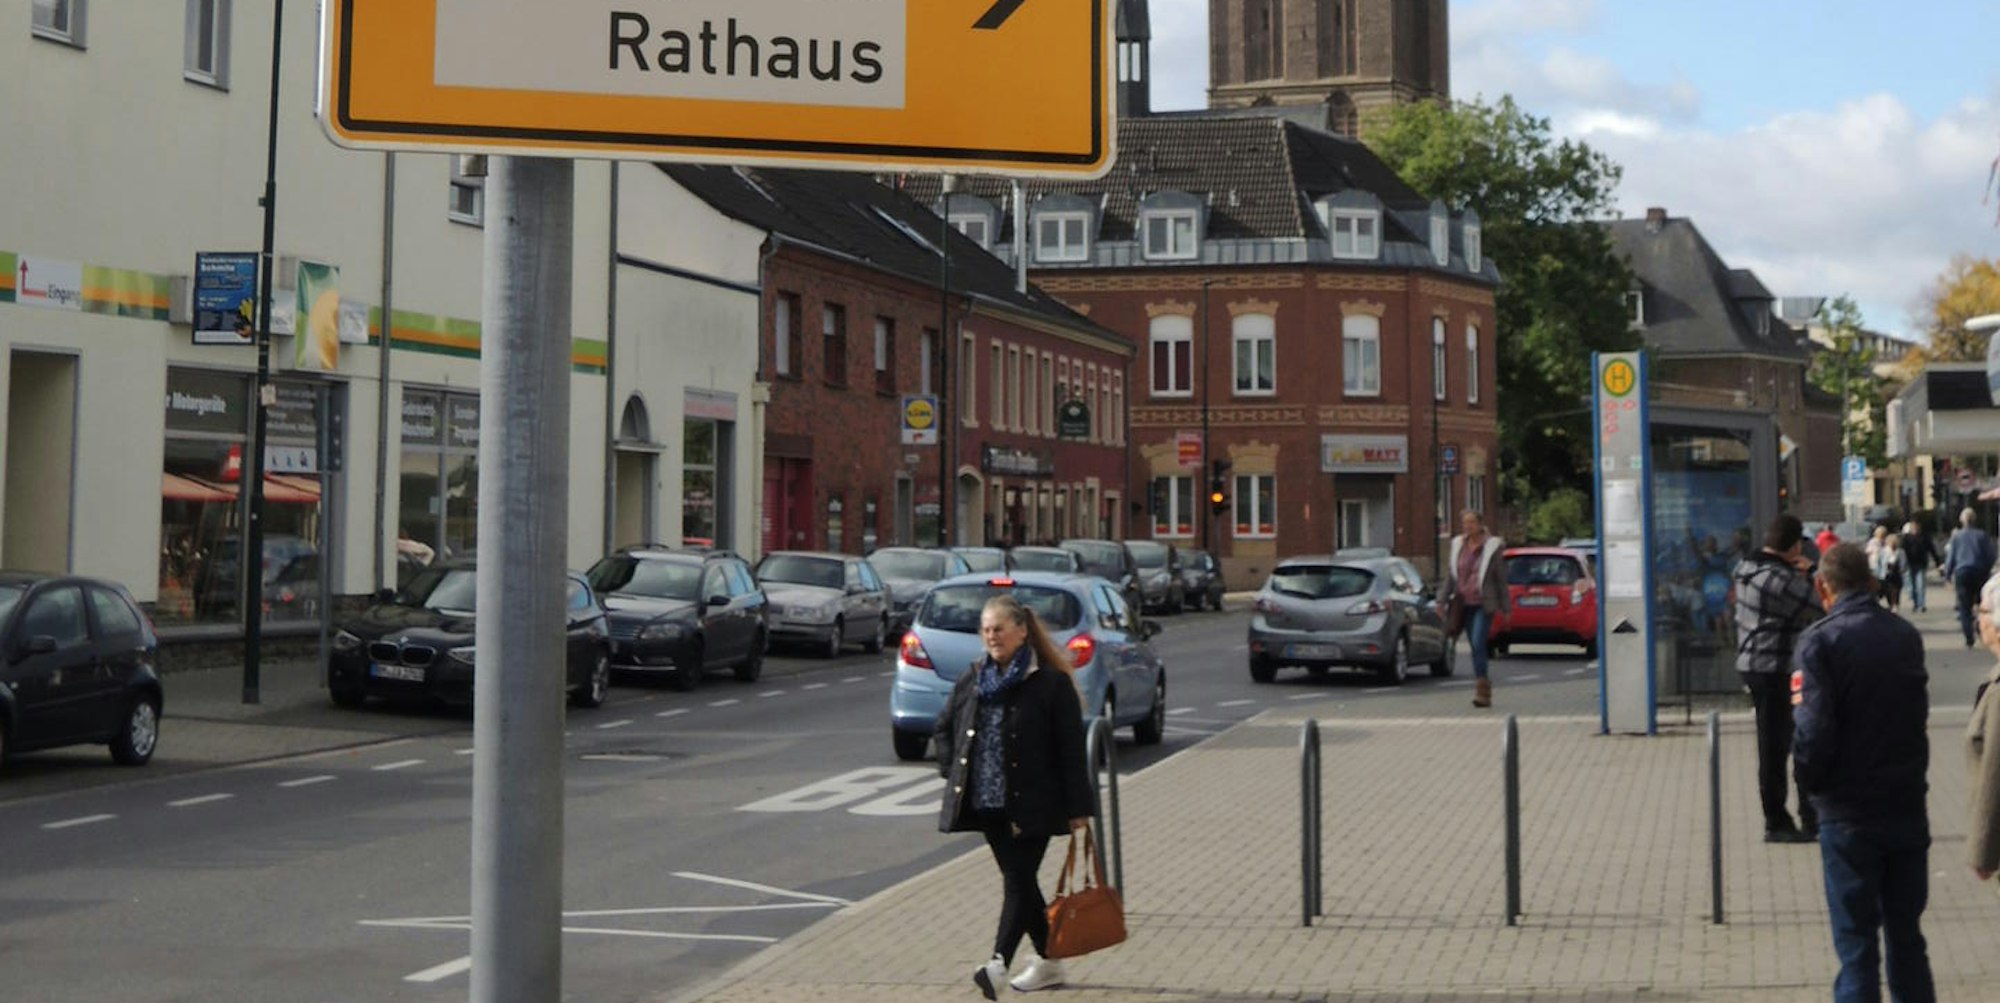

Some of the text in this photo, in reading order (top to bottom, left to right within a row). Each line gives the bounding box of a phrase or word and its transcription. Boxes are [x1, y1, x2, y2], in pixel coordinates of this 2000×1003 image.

[609, 11, 884, 84] Rathaus
[1611, 366, 1626, 389] H
[1847, 461, 1861, 479] P
